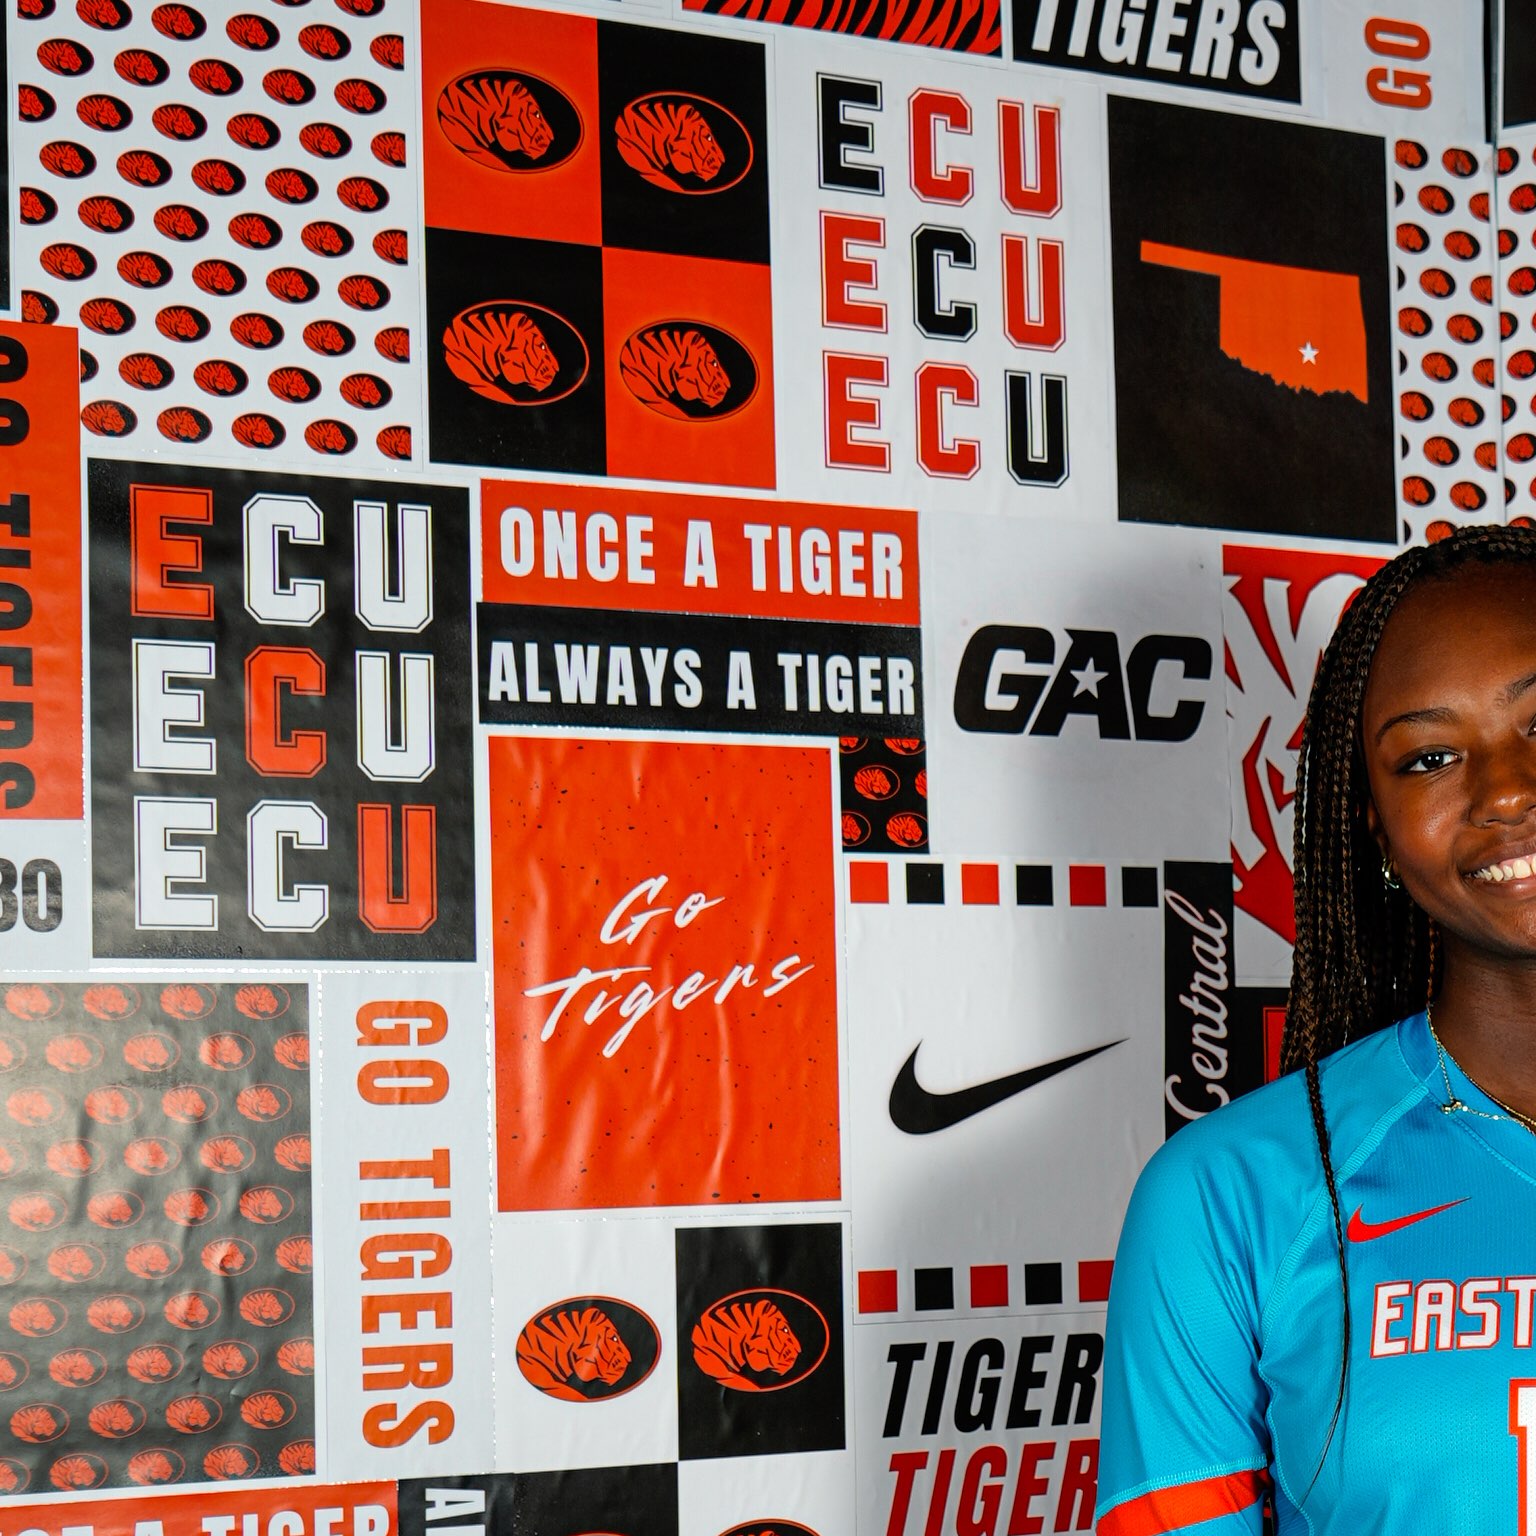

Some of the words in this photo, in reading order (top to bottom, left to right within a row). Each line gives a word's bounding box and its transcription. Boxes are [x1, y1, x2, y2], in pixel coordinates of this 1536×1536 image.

[1364, 16, 1432, 110] GO
[816, 71, 1063, 219] ECU
[818, 210, 1065, 353] ECU
[822, 350, 1069, 488] ECU
[130, 483, 433, 632] ECU
[499, 506, 656, 585] ONCE
[683, 519, 718, 589] A
[743, 523, 903, 600] TIGER
[131, 638, 435, 782] ECU
[488, 640, 703, 709] ALWAYS
[726, 650, 757, 710] A
[777, 652, 916, 716] TIGER
[953, 623, 1213, 742] GAC
[133, 795, 437, 935] ECU
[600, 874, 725, 945] Go
[355, 1000, 450, 1106] GO
[523, 954, 815, 1059] Tigers
[358, 1147, 455, 1449] TIGERS
[882, 1333, 1104, 1438] TIGER
